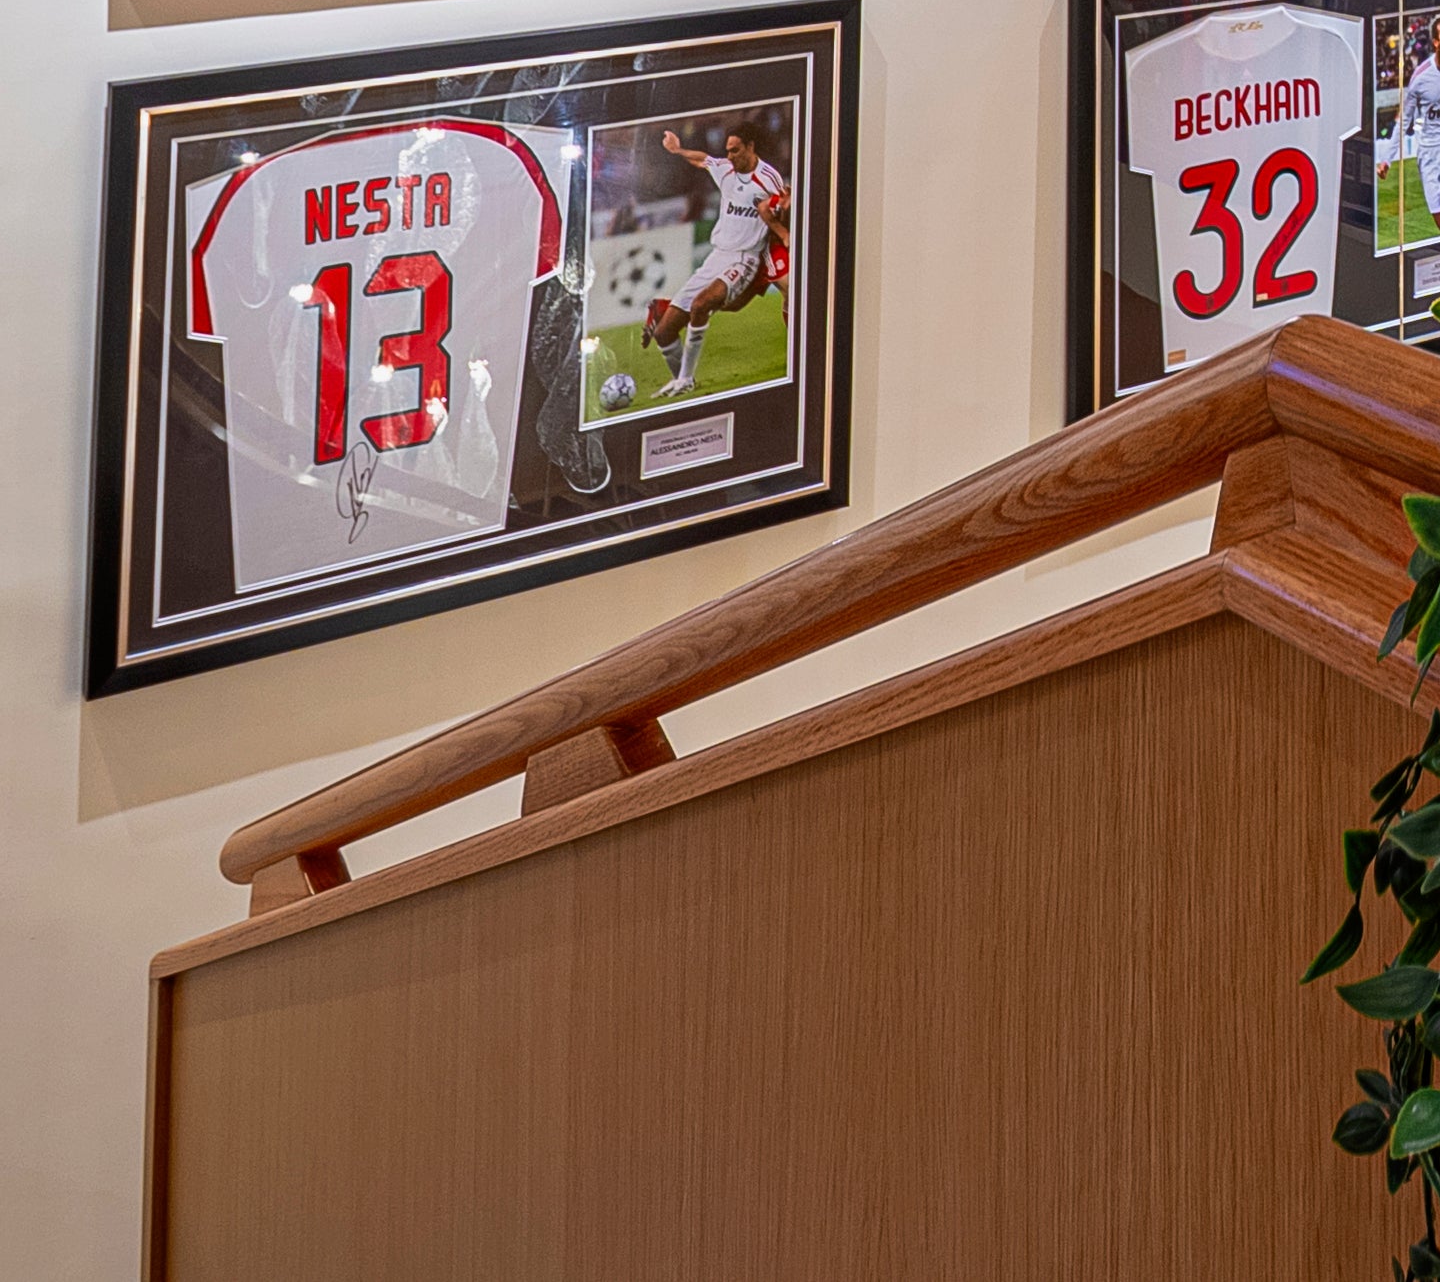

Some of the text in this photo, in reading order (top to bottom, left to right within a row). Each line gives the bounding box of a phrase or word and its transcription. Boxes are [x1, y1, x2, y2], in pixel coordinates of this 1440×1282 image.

[1174, 78, 1321, 141] BECKHAM
[305, 172, 452, 245] NESTA
[1172, 146, 1319, 320] 32
[302, 249, 453, 466] 13
